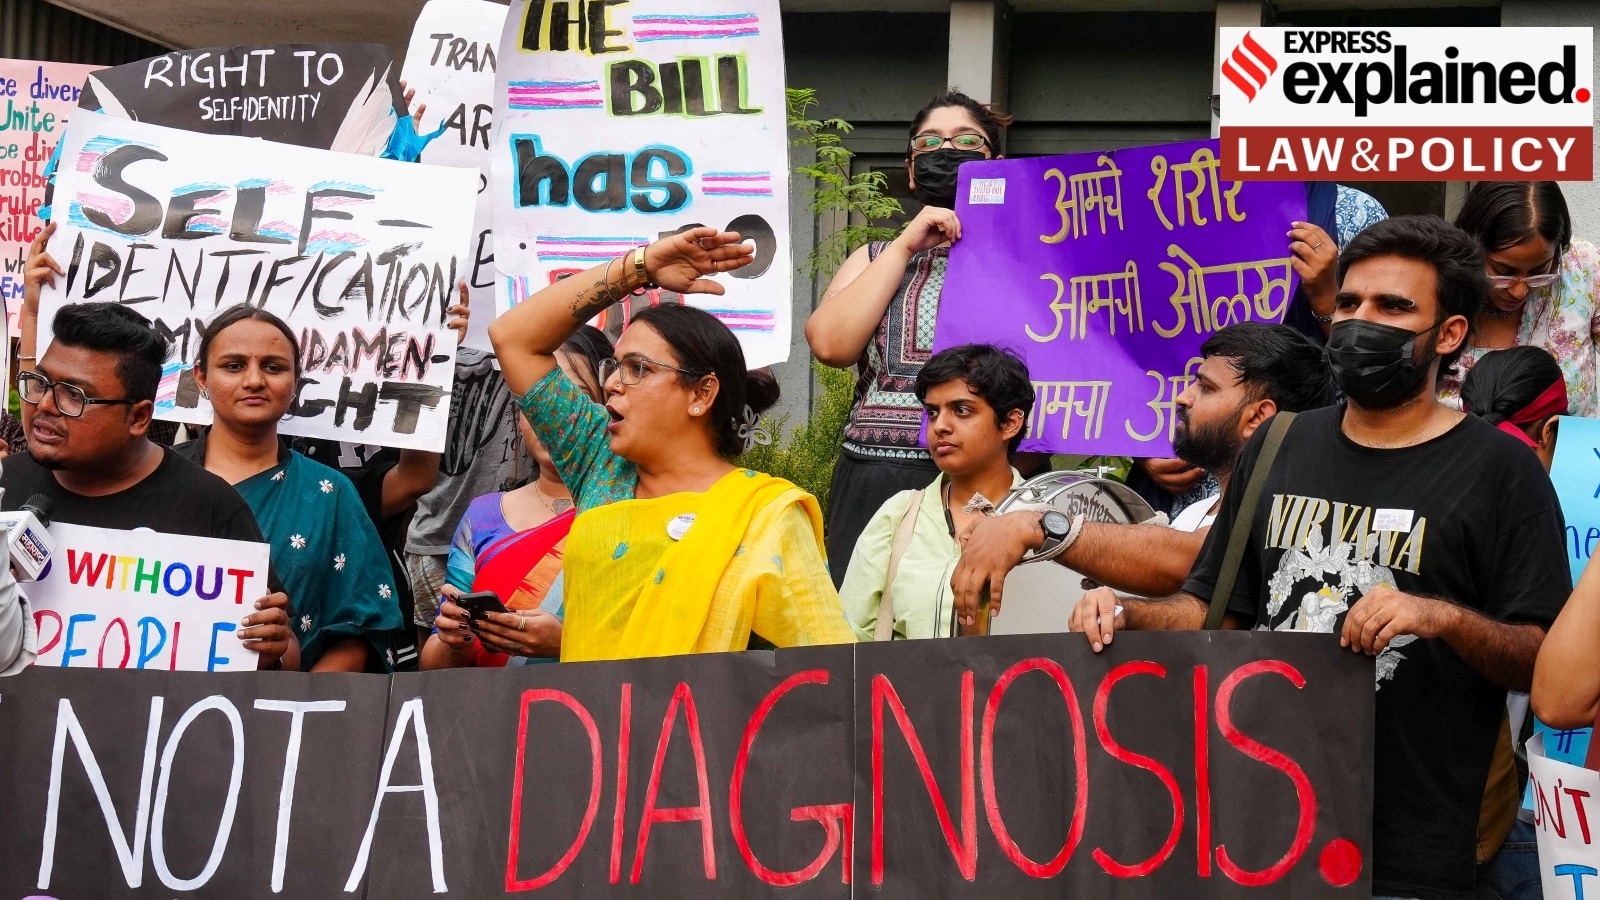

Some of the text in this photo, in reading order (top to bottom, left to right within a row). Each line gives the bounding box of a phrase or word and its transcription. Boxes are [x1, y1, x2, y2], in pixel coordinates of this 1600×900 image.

[521, 0, 631, 54] THE
[144, 50, 344, 89] RIGHT TO
[610, 55, 765, 117] BILL
[199, 92, 321, 123] SELF-IDENTITY
[512, 135, 691, 213] has
[65, 231, 458, 331] IDENTIFICATION
[1024, 259, 1144, 343] आमची
[1265, 494, 1427, 575] NIRVANA
[67, 549, 254, 604] WITHOUT
[37, 657, 1364, 893] NOT A DIAGNOSIS.
